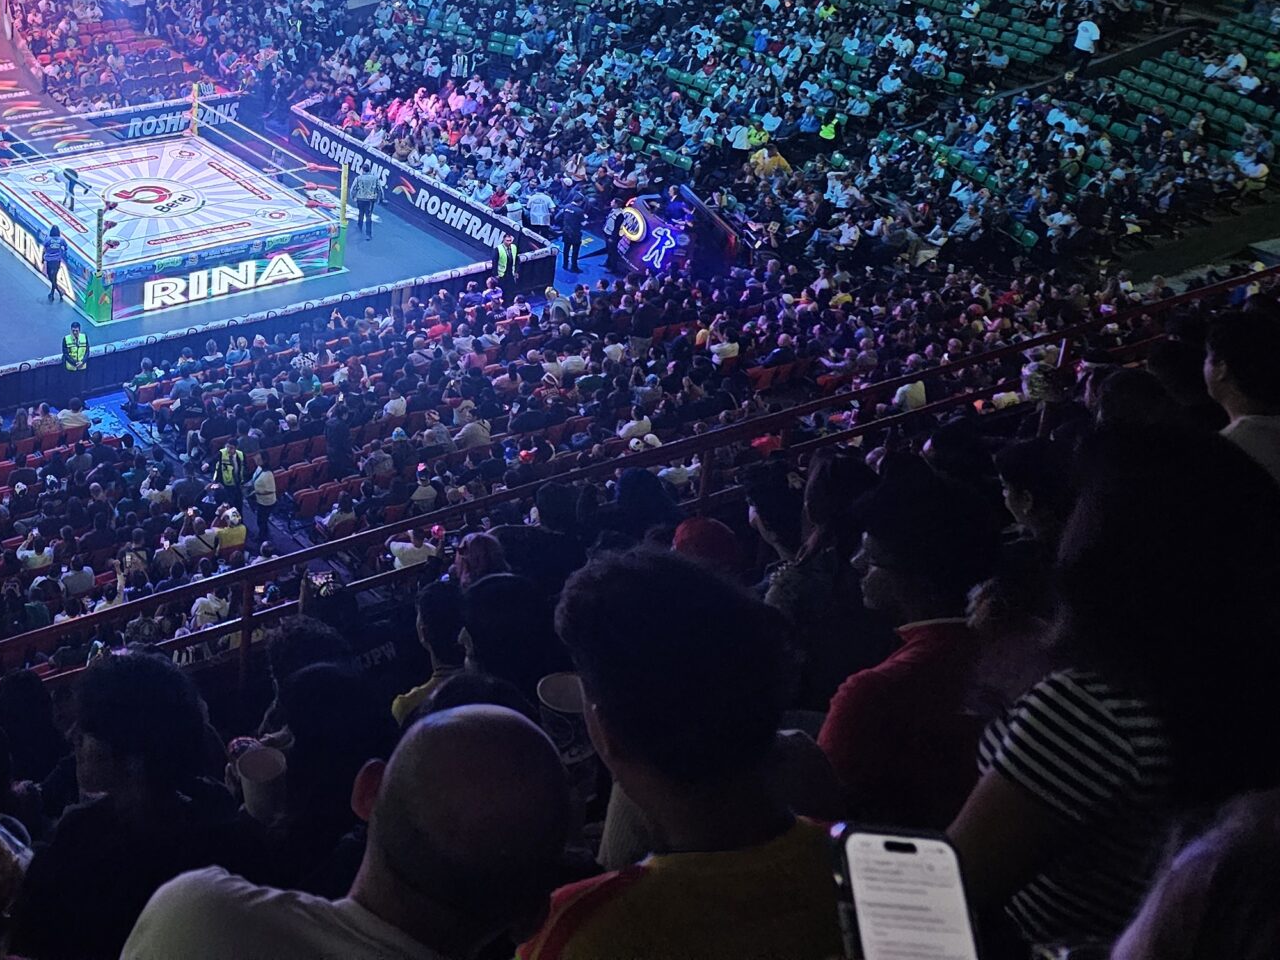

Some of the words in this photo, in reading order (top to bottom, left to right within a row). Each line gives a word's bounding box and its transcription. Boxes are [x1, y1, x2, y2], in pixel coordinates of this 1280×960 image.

[153, 194, 195, 213] Berel
[414, 188, 513, 250] ROSHFRAN
[144, 253, 305, 311] RINA
